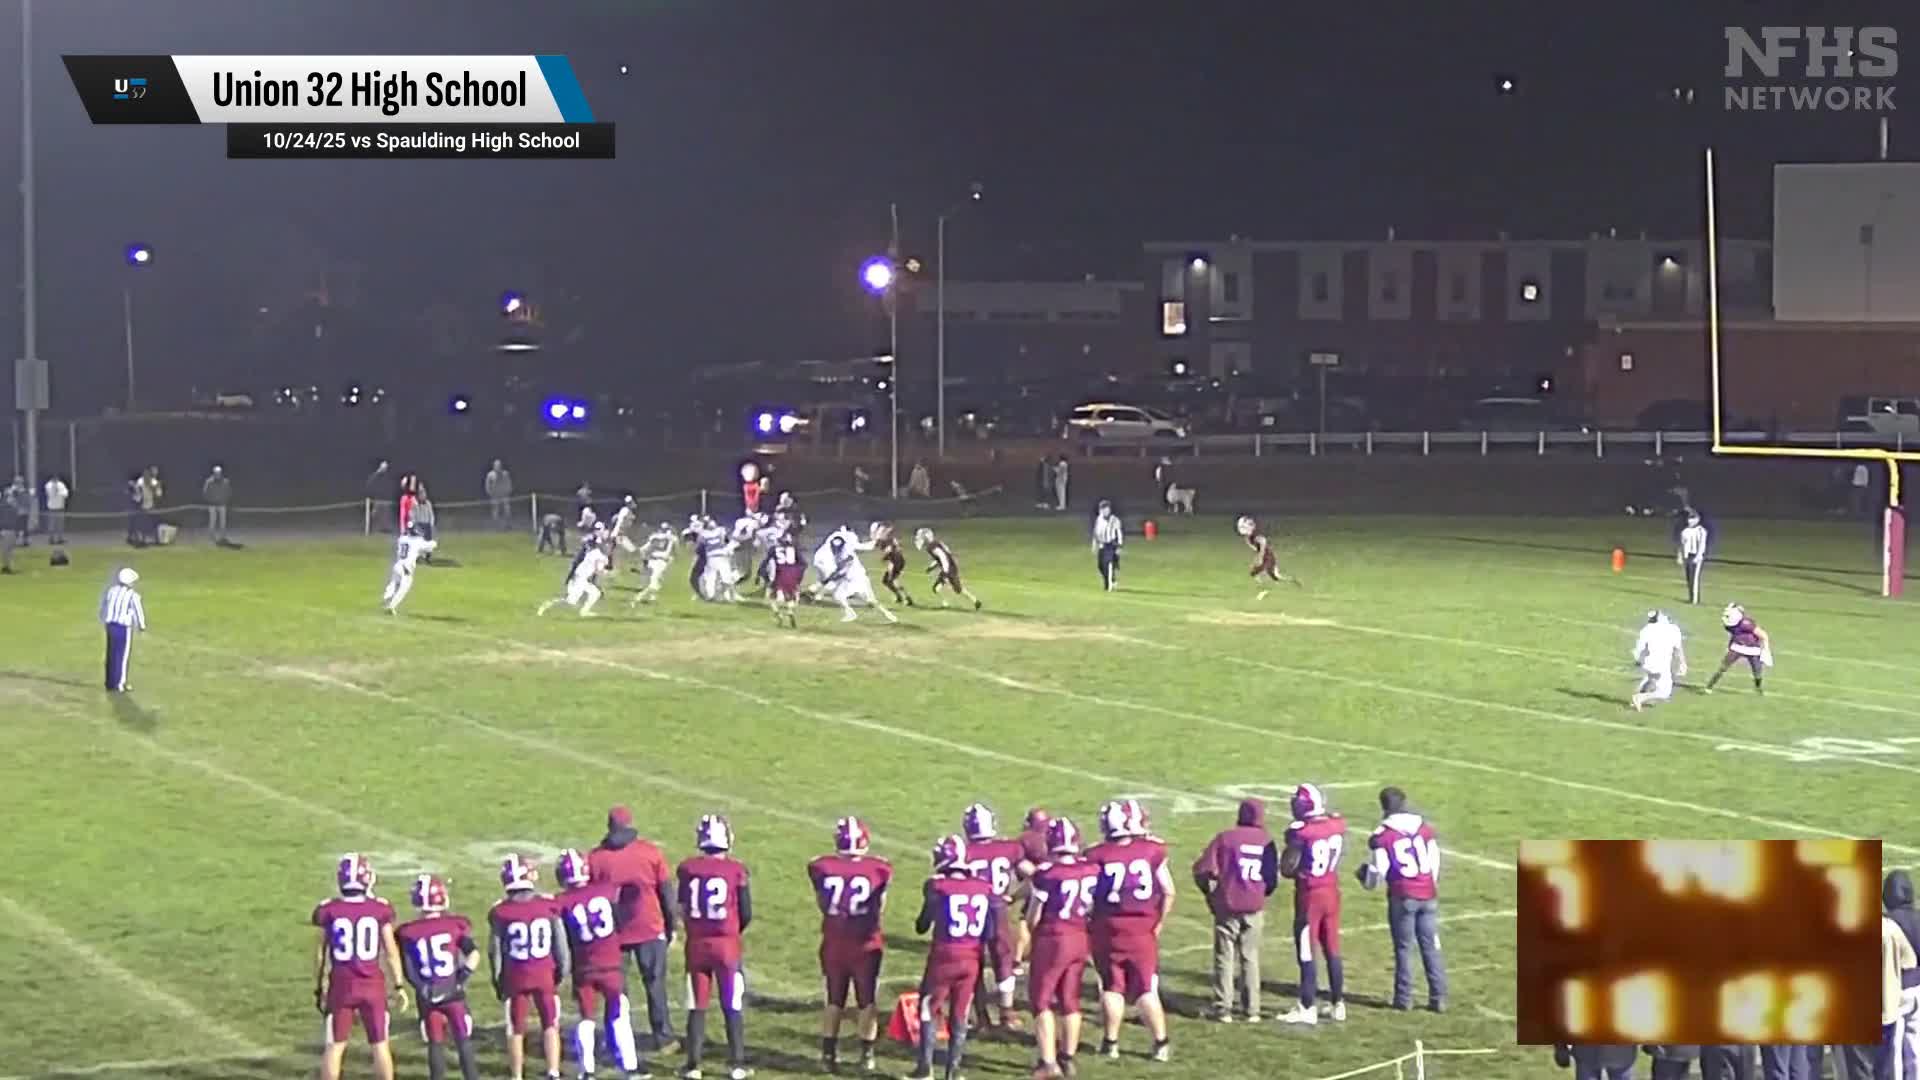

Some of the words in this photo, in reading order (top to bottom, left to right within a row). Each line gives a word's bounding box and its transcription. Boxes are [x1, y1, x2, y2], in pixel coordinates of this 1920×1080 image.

[1311, 834, 1343, 877] 87
[689, 877, 728, 920] 12
[823, 876, 871, 916] 72
[1058, 875, 1098, 920] 75
[1104, 858, 1153, 904] 73
[506, 916, 552, 959] 20
[571, 896, 614, 943] 13
[948, 894, 989, 938] 53
[332, 916, 380, 962] 30
[416, 933, 455, 978] 15
